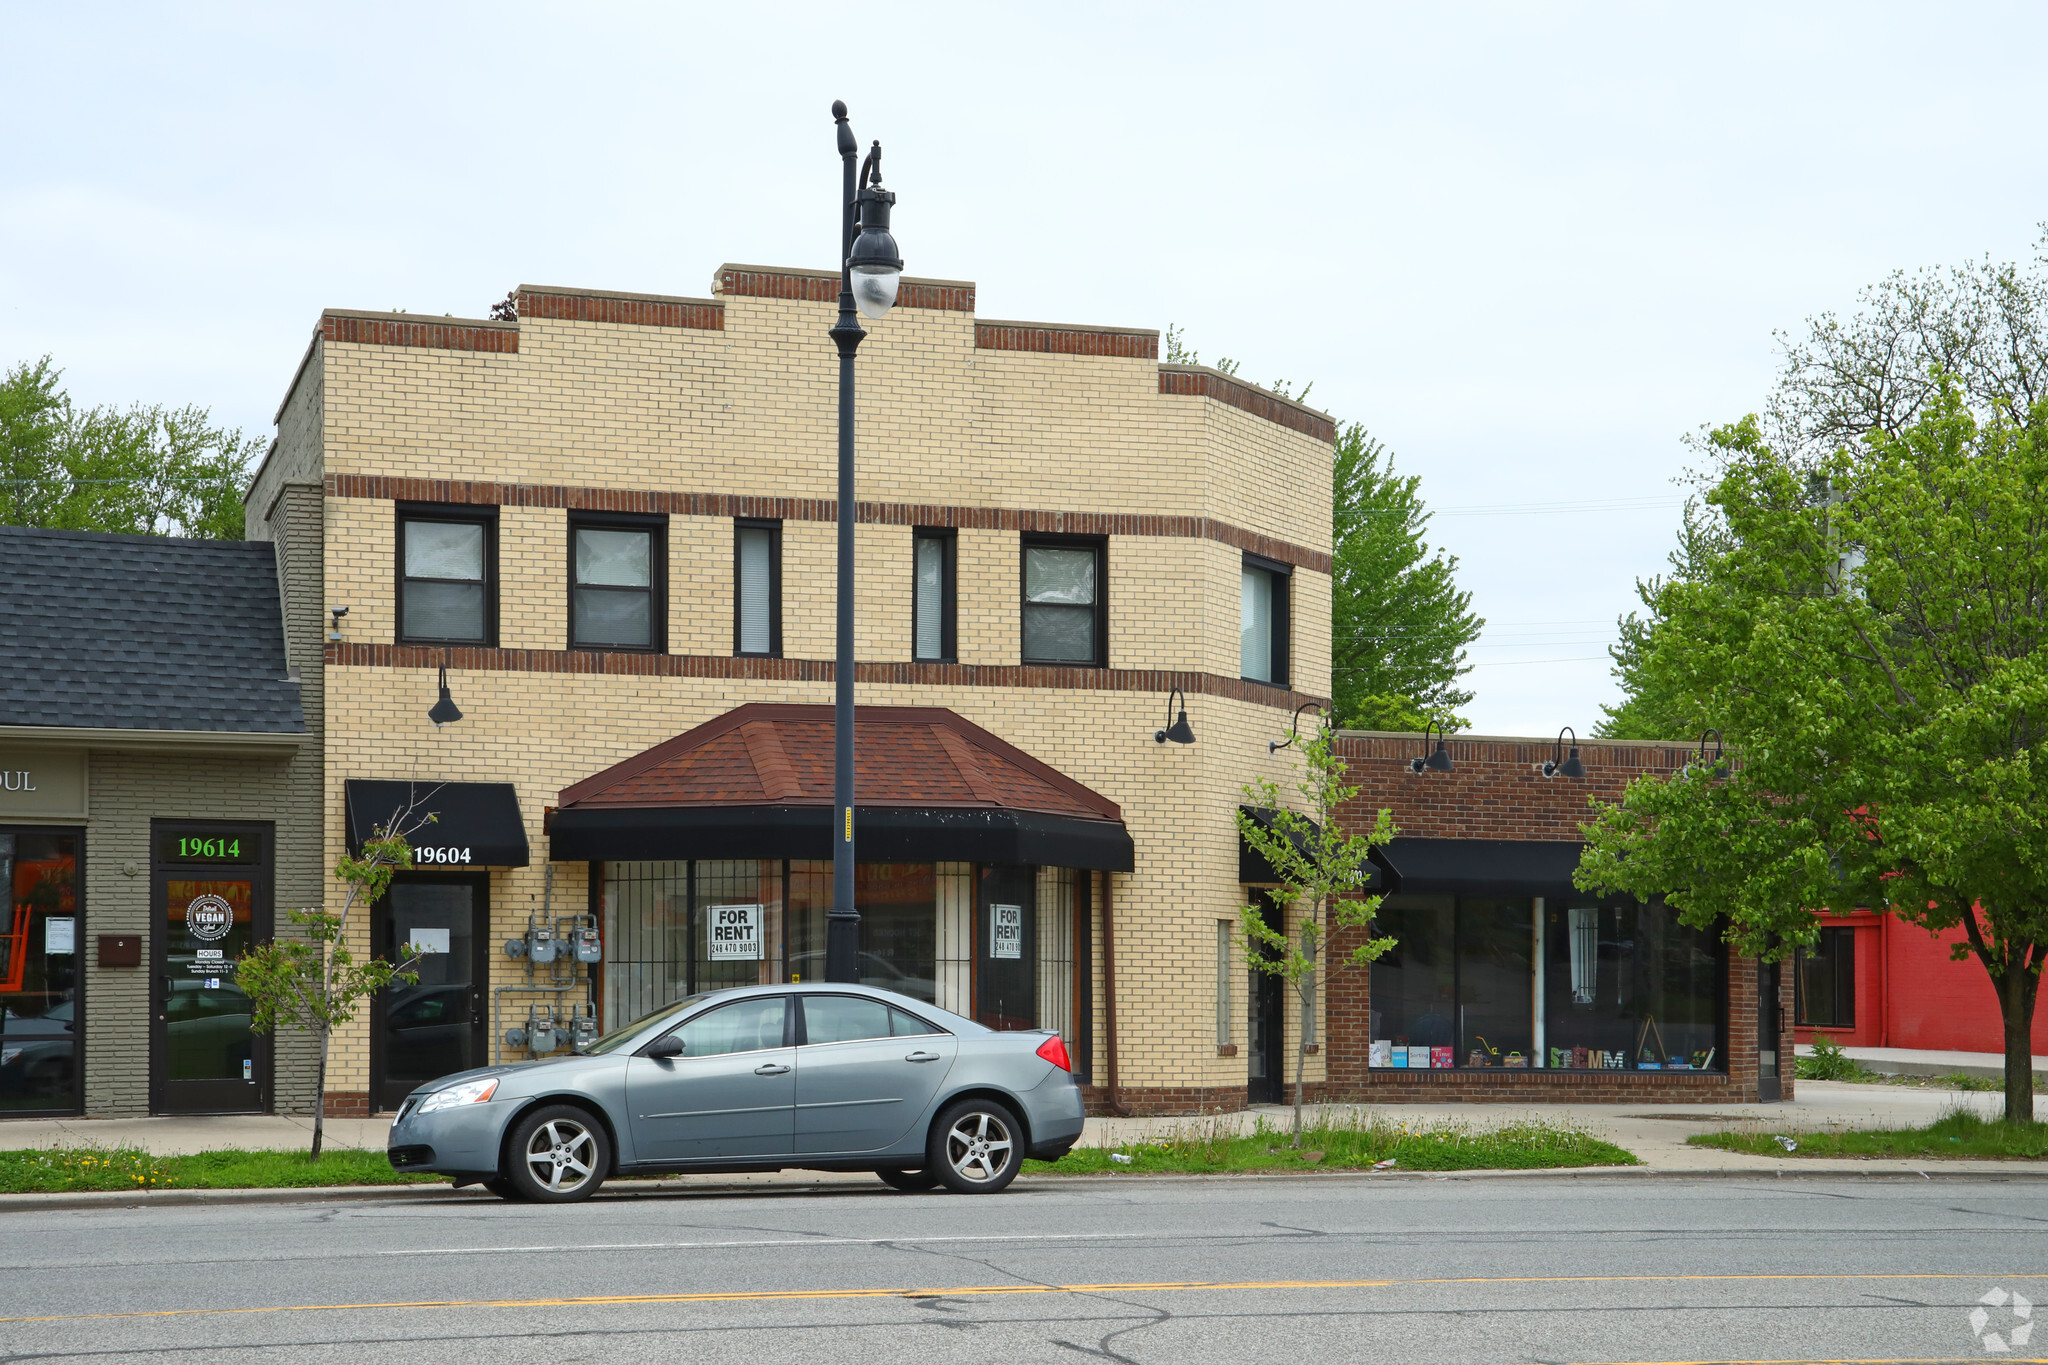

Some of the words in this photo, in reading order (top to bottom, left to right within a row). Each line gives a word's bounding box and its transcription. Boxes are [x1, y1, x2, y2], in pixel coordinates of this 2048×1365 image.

[0, 771, 37, 791] UL
[179, 838, 240, 857] 19614
[414, 847, 471, 863] 19604
[195, 913, 225, 922] VEGAN
[719, 910, 748, 924] FOR
[1000, 910, 1018, 924] FOR
[715, 926, 753, 940] RENT
[996, 925, 1020, 940] RENT
[725, 943, 737, 952] 470
[739, 943, 757, 952] 9003
[1551, 1047, 1625, 1069] STEMM
